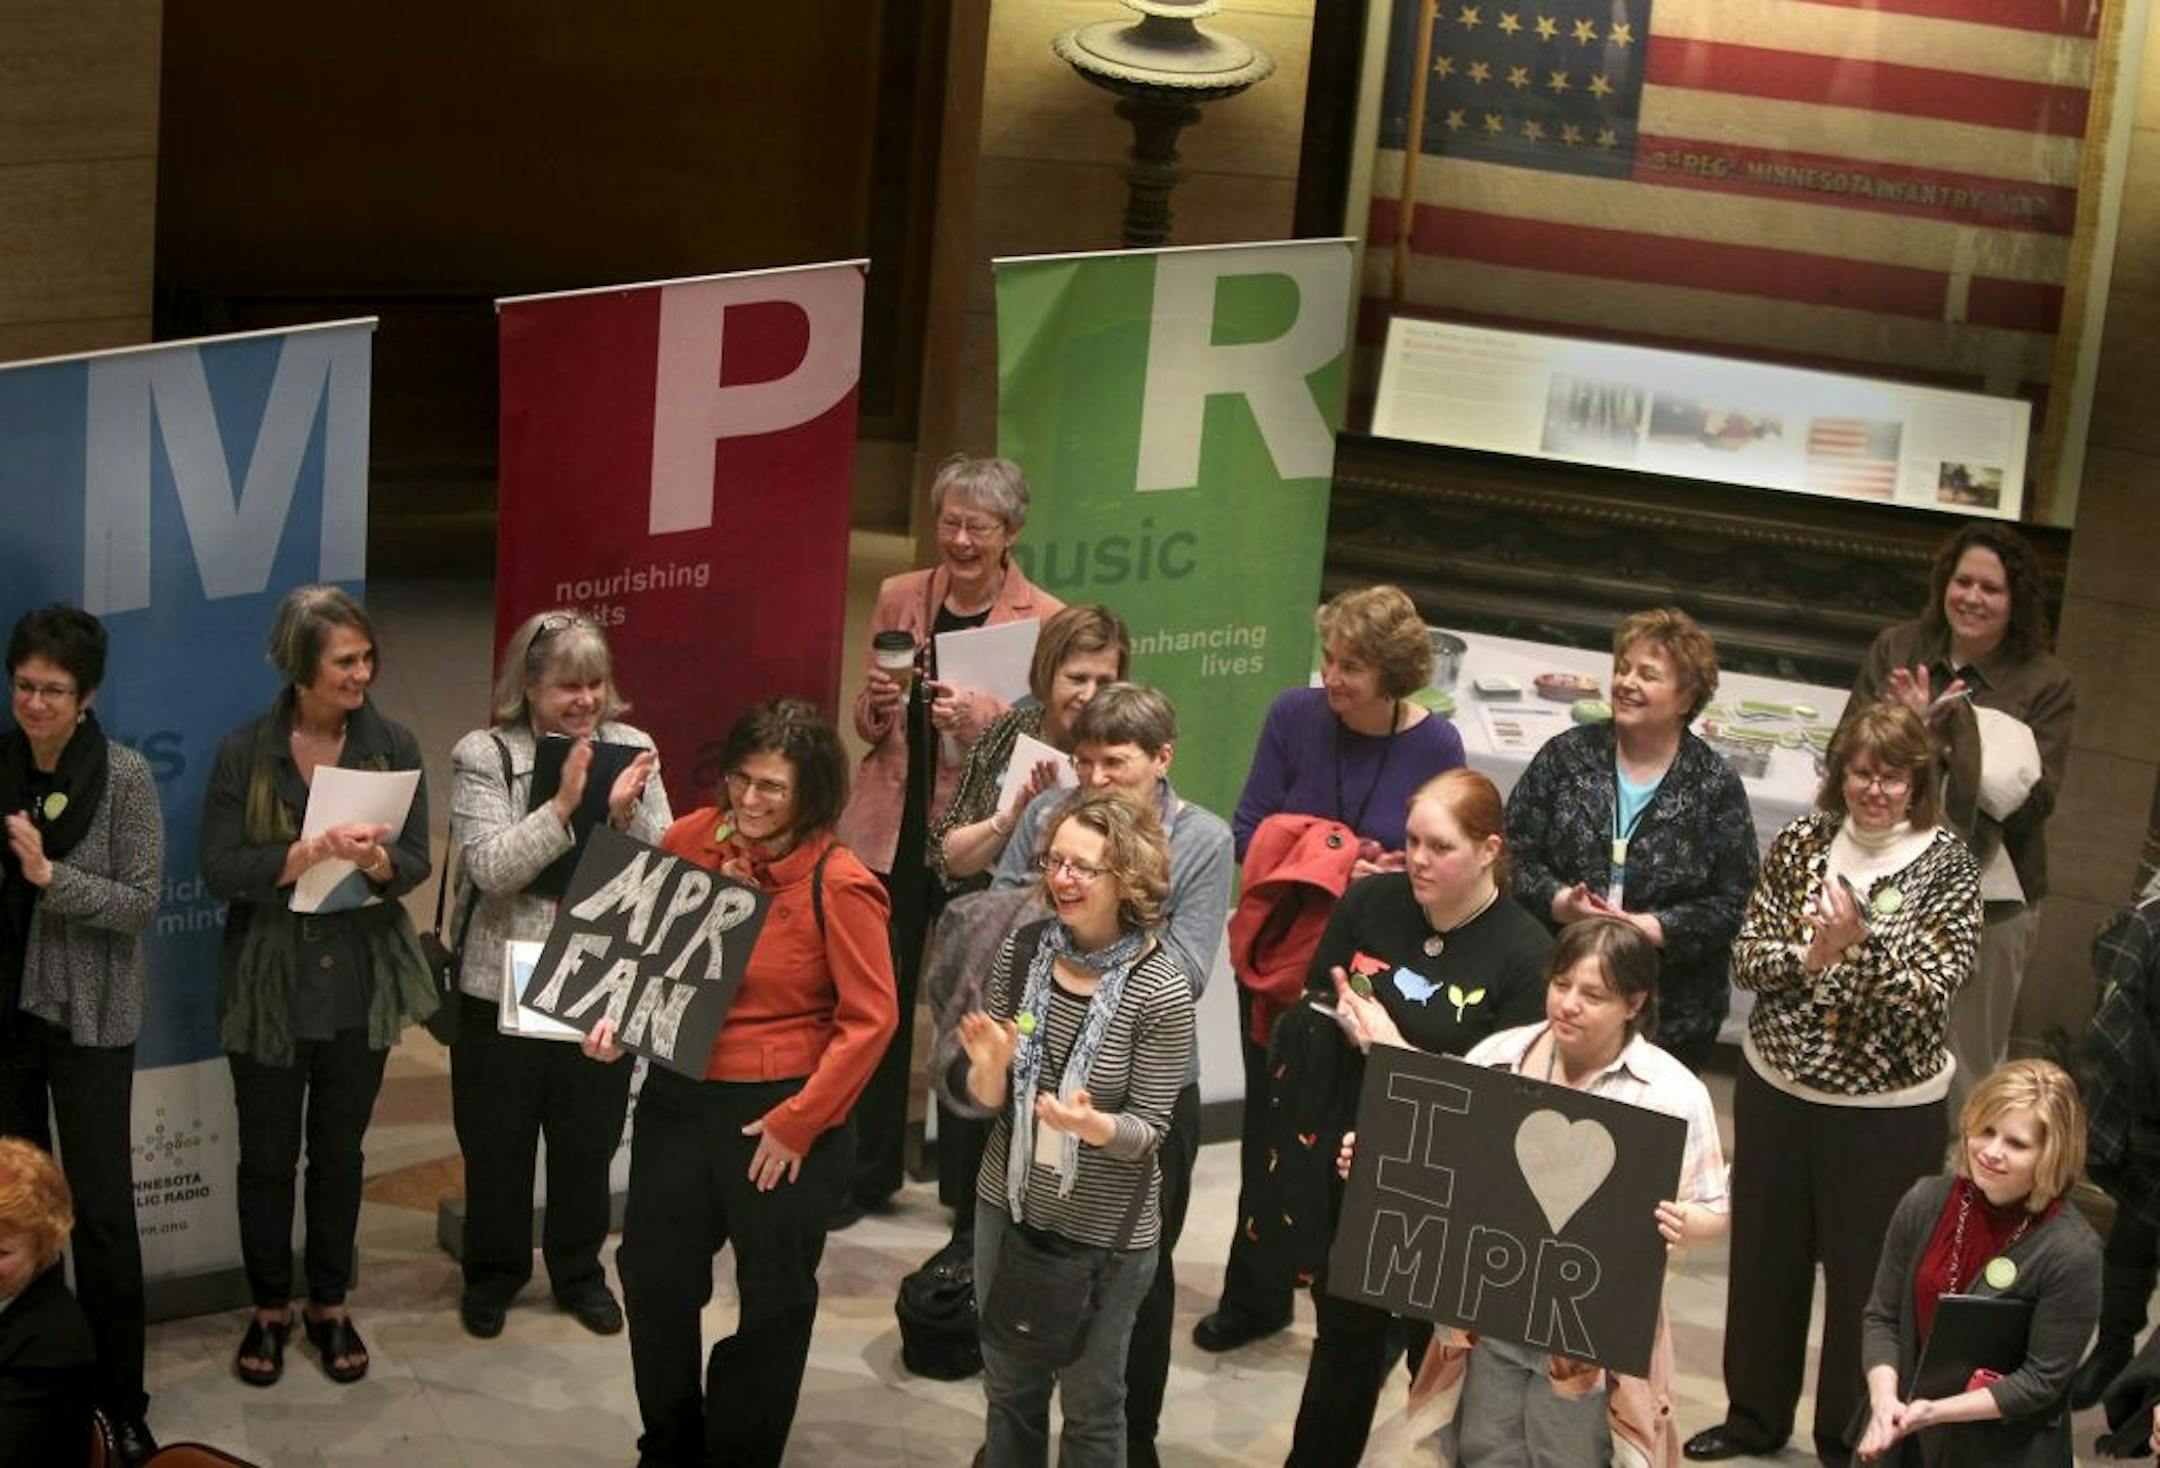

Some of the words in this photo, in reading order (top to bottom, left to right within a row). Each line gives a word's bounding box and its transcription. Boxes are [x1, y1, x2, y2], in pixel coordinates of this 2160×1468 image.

[649, 265, 866, 536] P
[1136, 244, 1353, 492] R
[84, 326, 373, 617] M
[555, 563, 710, 602] nourishing
[1201, 653, 1264, 677] lives
[570, 850, 756, 980] MPR
[533, 932, 698, 1061] FAN
[163, 1186, 210, 1205] RADIO
[1377, 1073, 1472, 1209] I
[1362, 1210, 1601, 1360] MPR
